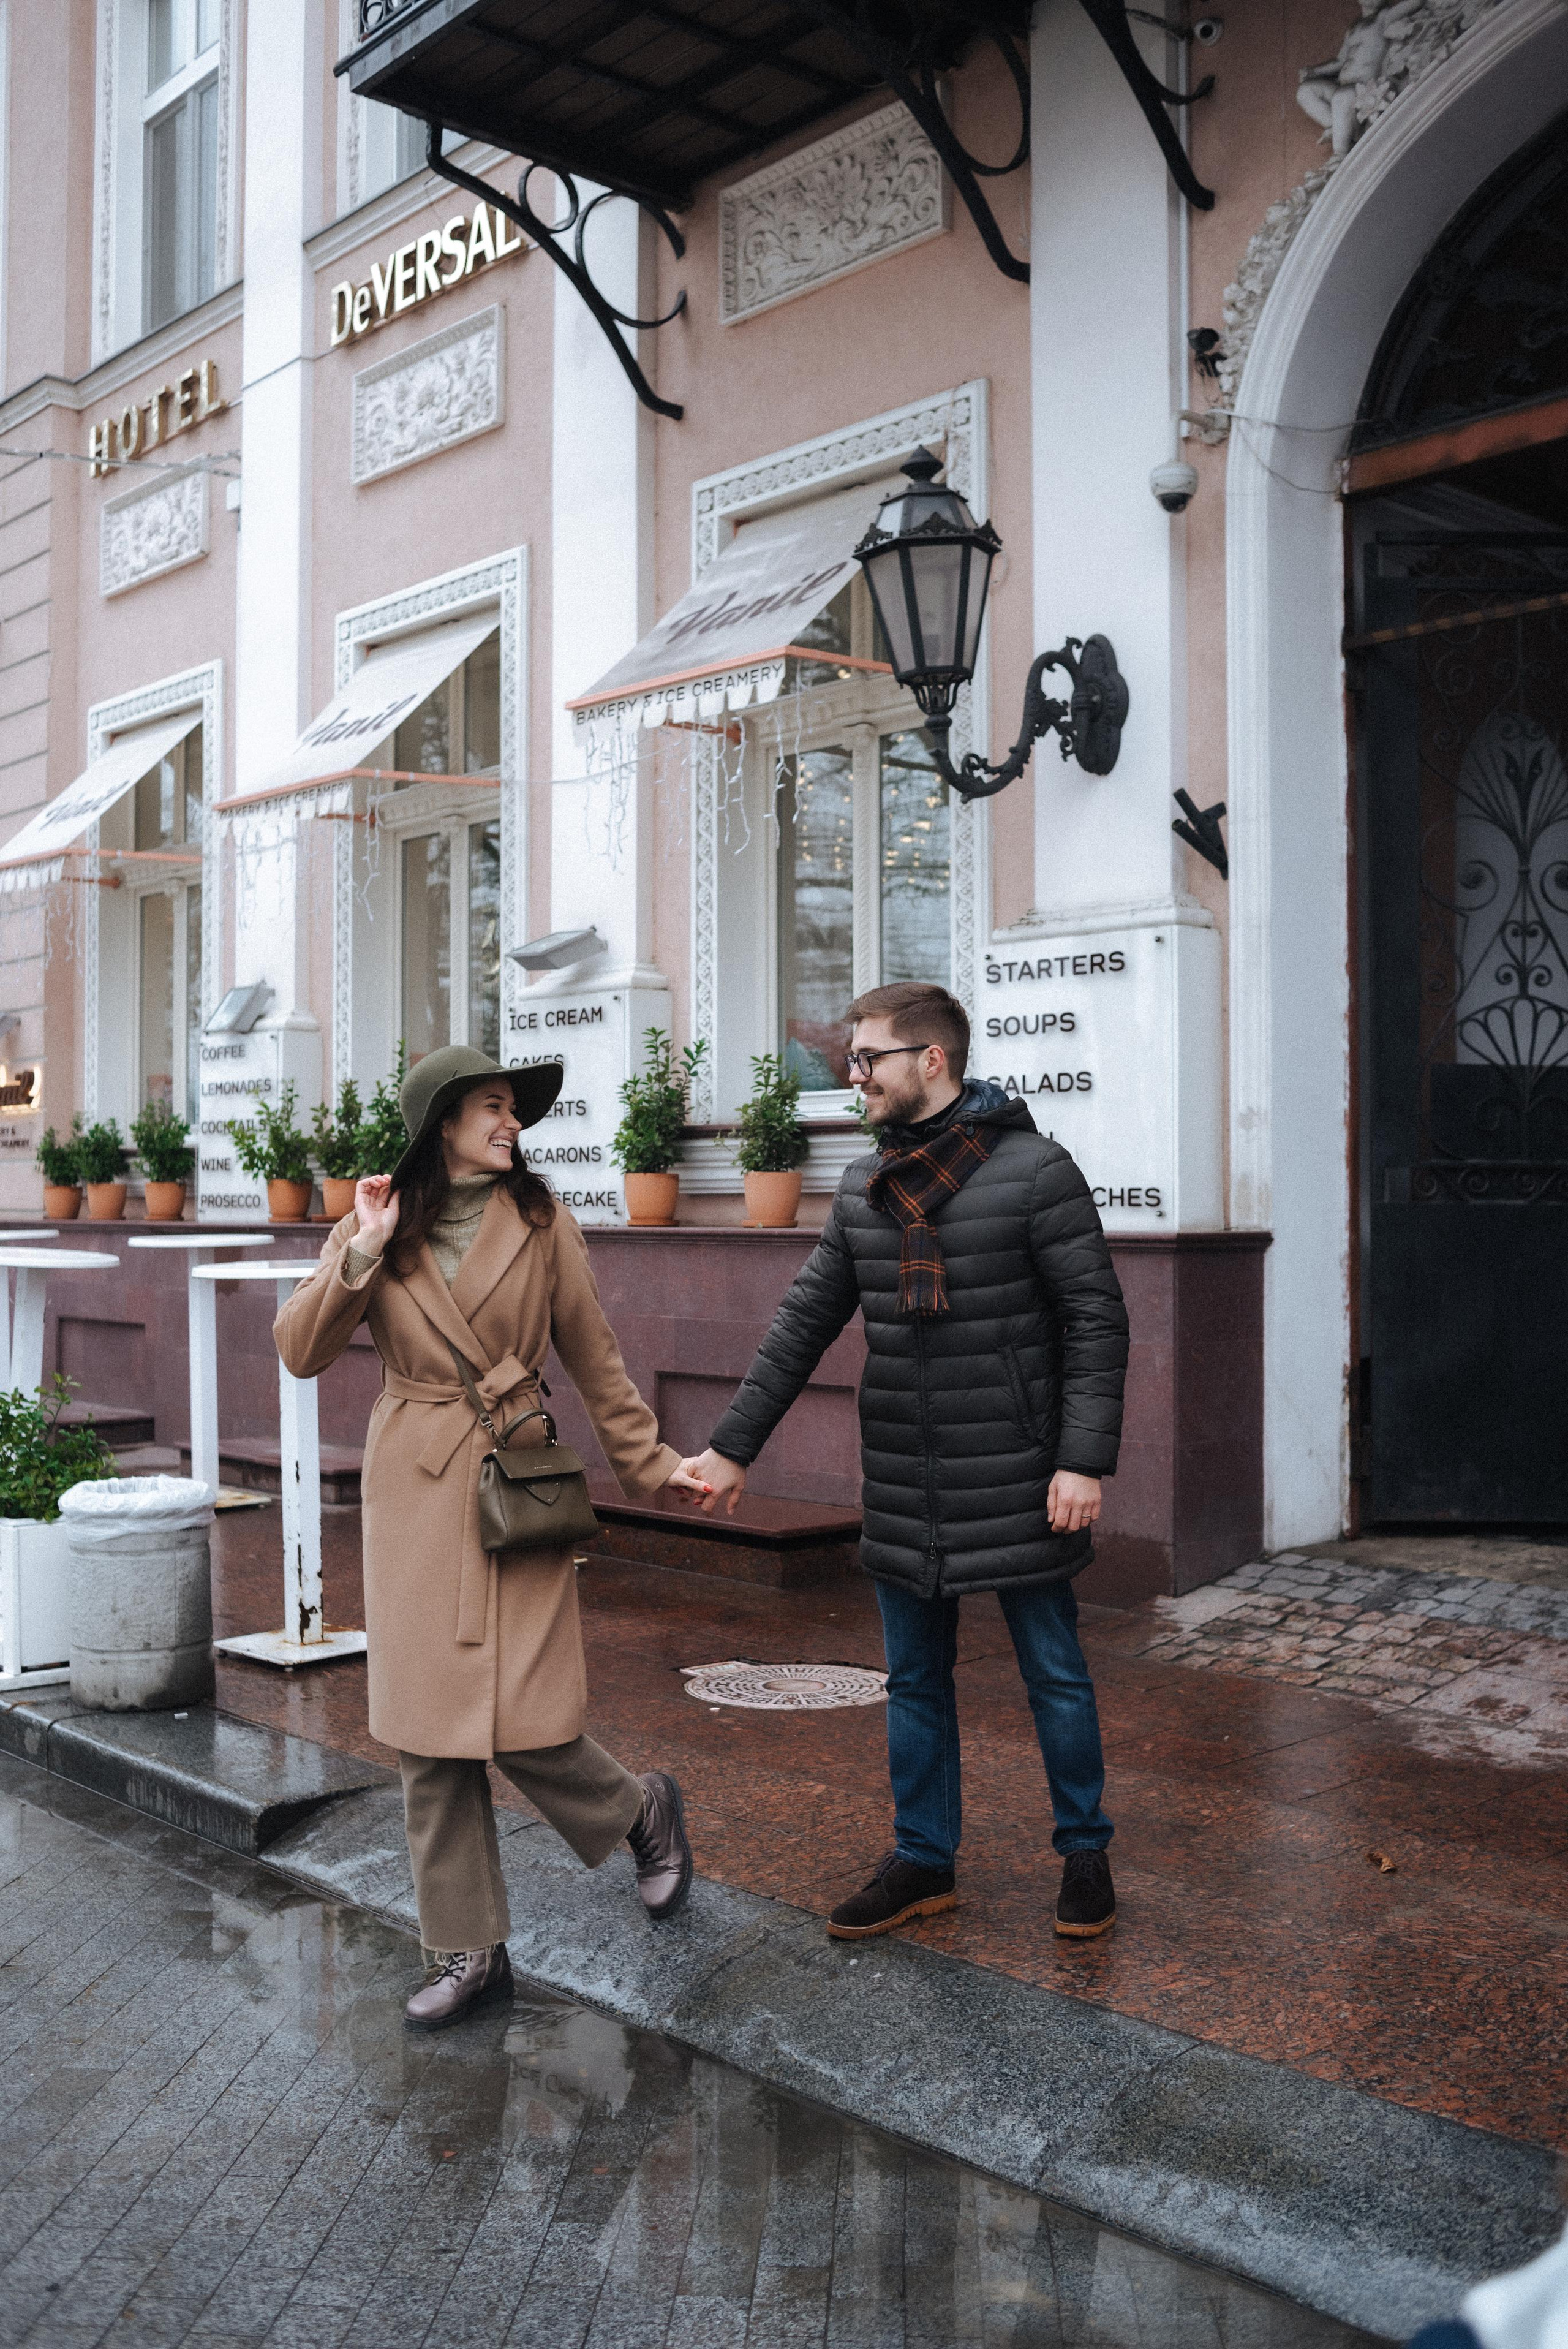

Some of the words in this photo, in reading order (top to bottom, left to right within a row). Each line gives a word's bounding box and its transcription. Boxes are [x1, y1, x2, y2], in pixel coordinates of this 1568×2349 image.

[89, 359, 227, 478] HOTEL
[576, 698, 637, 725] BAKERY
[656, 686, 685, 705] ICE
[692, 662, 783, 697] CREAMERY
[986, 951, 1125, 984] STARTERS
[510, 1013, 537, 1031] ICE
[545, 1005, 603, 1027] CREAM
[986, 1012, 1076, 1038] SOUPS
[202, 1044, 246, 1061] COFFEE
[201, 1078, 271, 1096] LEMONADES
[200, 1157, 232, 1171] WINE
[524, 1146, 602, 1164] ACARONS
[200, 1194, 261, 1208] PROSECCO
